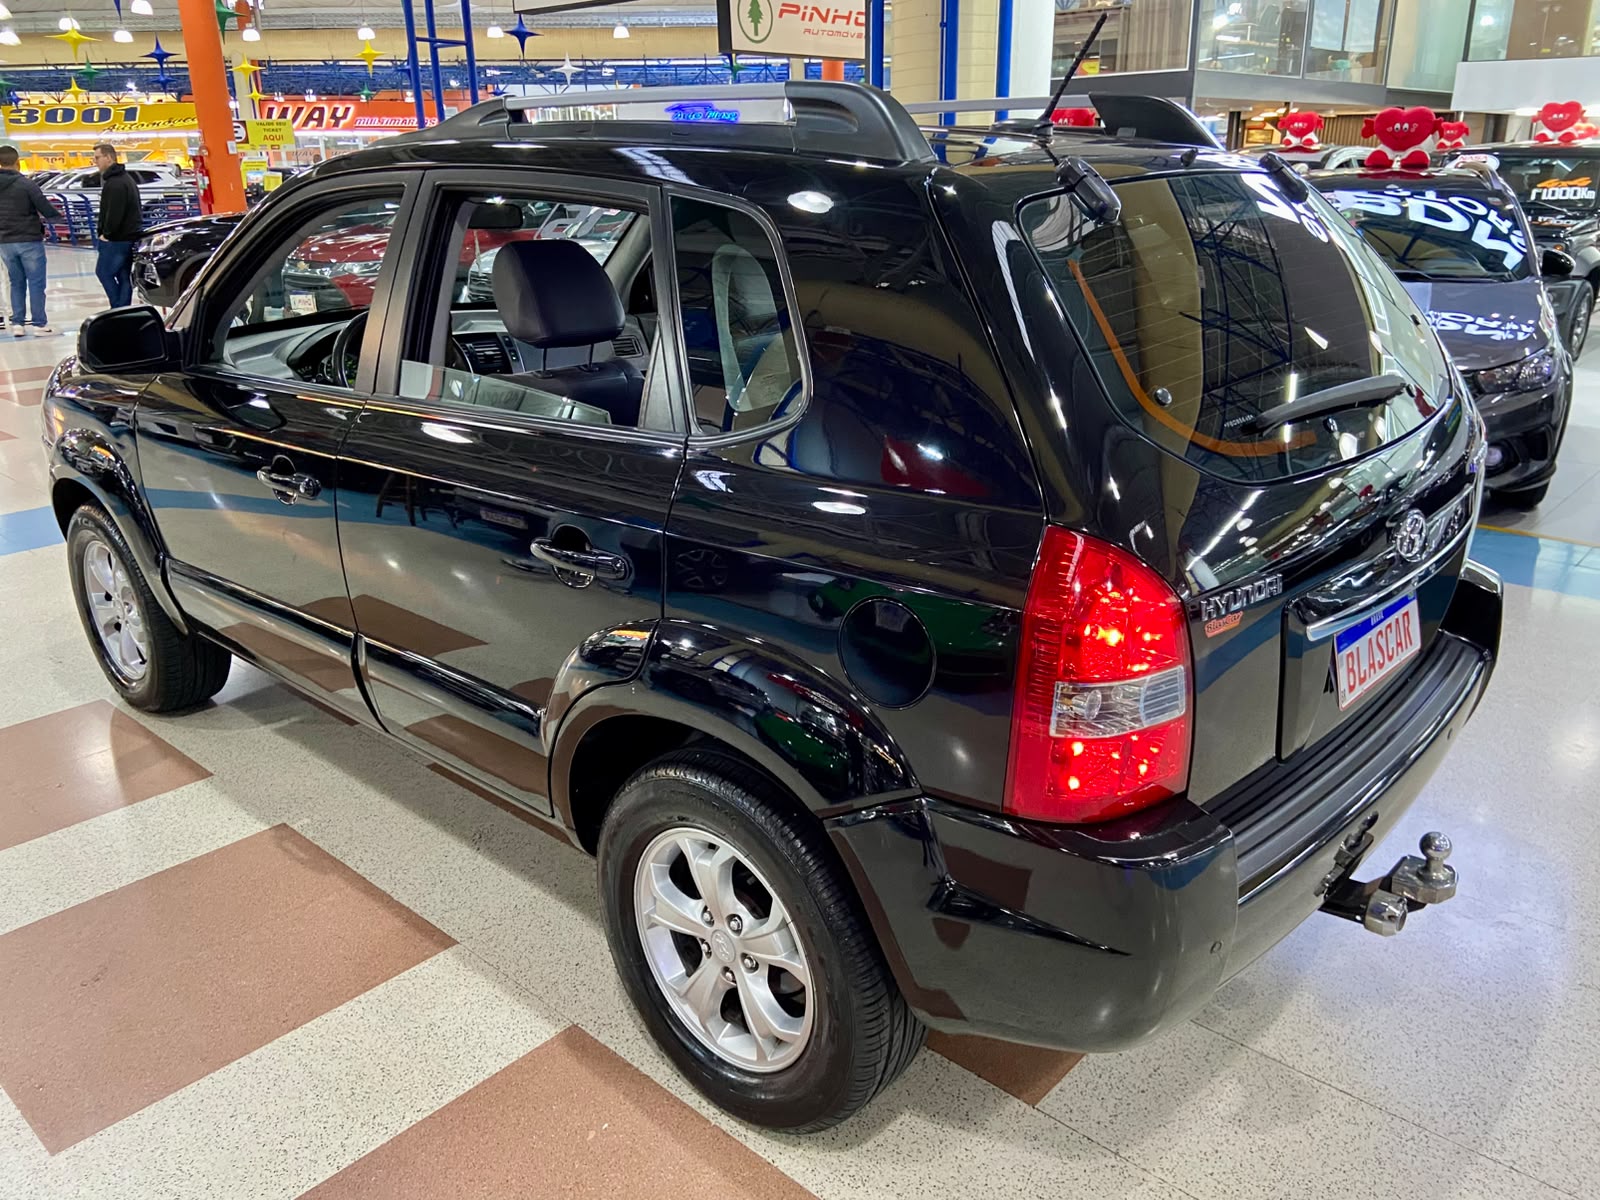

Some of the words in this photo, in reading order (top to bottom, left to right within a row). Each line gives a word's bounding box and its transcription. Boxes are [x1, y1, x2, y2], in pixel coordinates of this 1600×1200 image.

[7, 105, 141, 126] 3001
[264, 105, 352, 128] WAY
[263, 134, 285, 142] AQUI
[1200, 573, 1283, 622] HYUNDAI
[1346, 610, 1413, 694] BLASCAR
